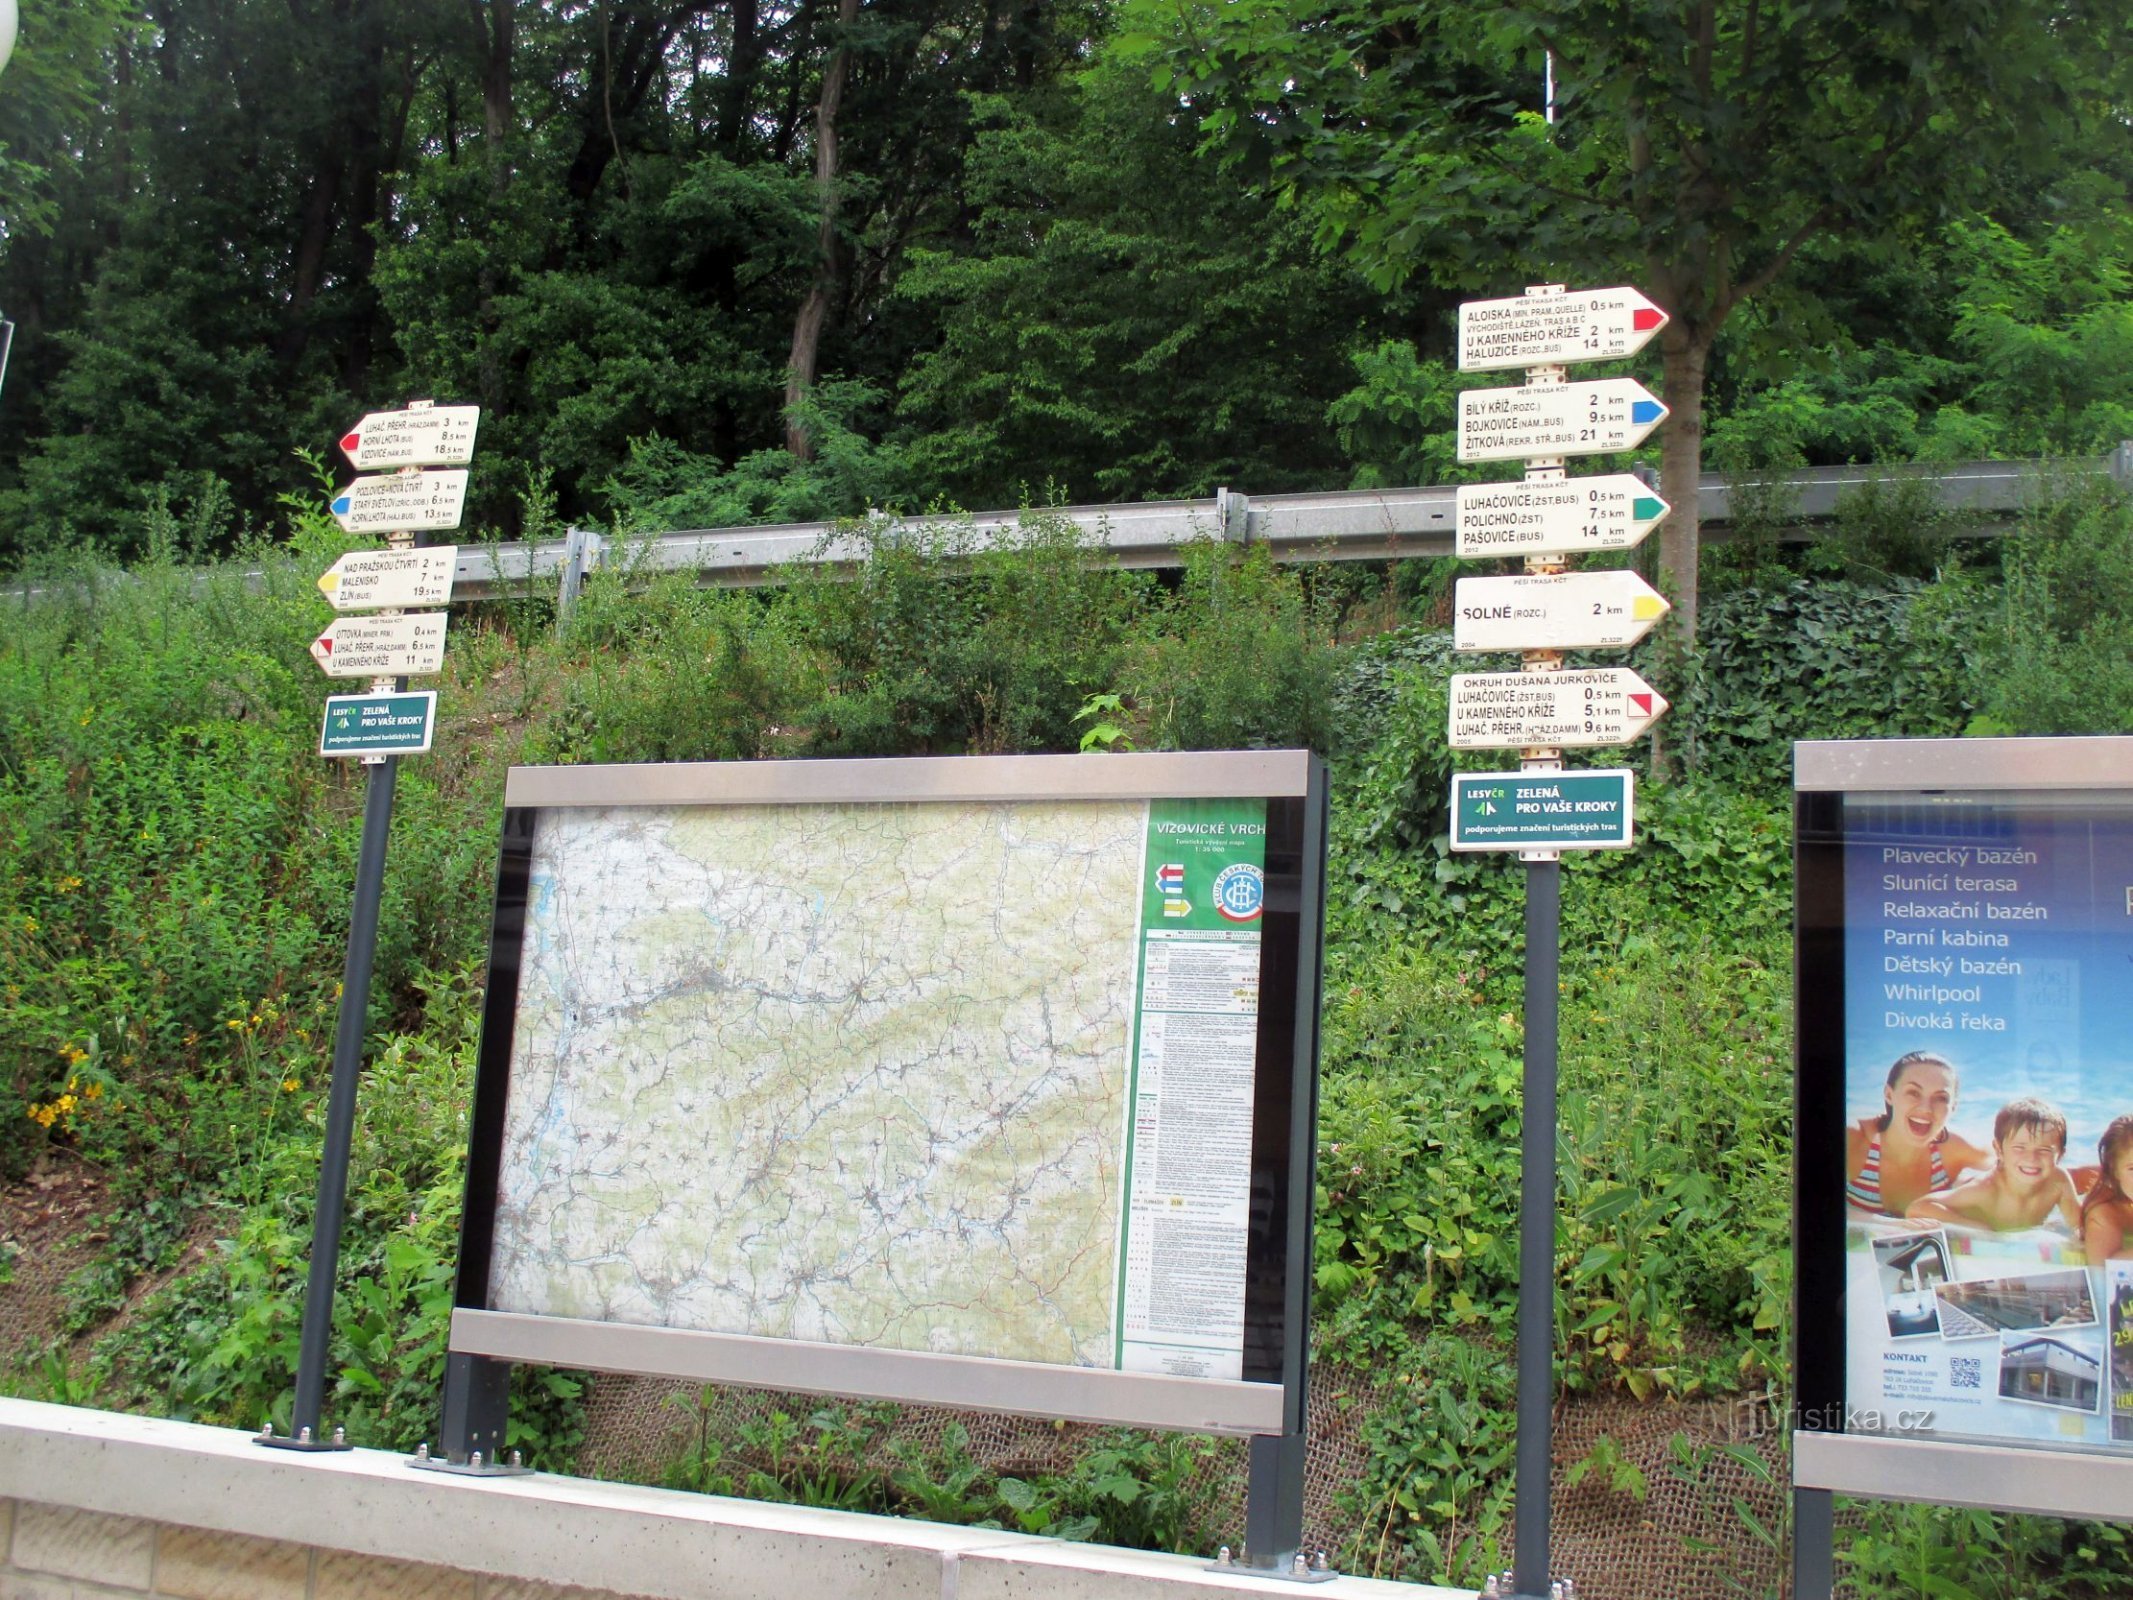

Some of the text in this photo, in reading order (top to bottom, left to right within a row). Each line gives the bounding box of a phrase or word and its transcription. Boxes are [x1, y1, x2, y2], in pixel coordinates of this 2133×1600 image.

[1467, 308, 1512, 322] ALOISKA
[1590, 300, 1606, 312] 0,5
[1609, 301, 1624, 309] km
[1544, 317, 1564, 326] TRAS
[1566, 316, 1572, 324] A
[1572, 316, 1578, 324] B
[1466, 325, 1624, 347] U KAMENNÉHO KŘÍŽE 2 km
[1466, 345, 1518, 360] HALUZICE
[1584, 338, 1598, 349] 14
[1466, 394, 1624, 416] BÍLÝ KŘÍŽ (ROZC.) 2 km
[444, 418, 450, 427] 3
[1466, 418, 1518, 432] BOJKOVICE
[1590, 412, 1606, 423] 9,5
[363, 436, 380, 446] HORNÍ
[380, 436, 400, 445] LHOTA
[442, 432, 454, 441] 8,5
[1466, 433, 1505, 450] ŽITKOVÁ
[1580, 429, 1596, 440] 21
[361, 449, 387, 460] VIZOVICE
[434, 444, 452, 454] 18,5
[434, 482, 440, 491] 3
[432, 496, 442, 504] 6,5
[1464, 494, 1531, 510] LUHAČOVICE
[1590, 490, 1606, 502] 0,5
[1610, 492, 1624, 500] km
[369, 512, 386, 522] LHOTA
[425, 509, 440, 518] 13,5
[1464, 508, 1624, 527] POLICHNO (ŽST) 7,5 km
[1464, 525, 1624, 544] PAŠOVICE (BUS) 14 km
[344, 564, 358, 573] NAD
[360, 560, 393, 572] PRAŽSKOU
[394, 558, 418, 570] ČTVRTÍ
[422, 558, 428, 568] 2
[342, 576, 378, 587] MALENISKO
[421, 572, 427, 582] 7
[340, 590, 354, 600] ZLÍN
[354, 592, 372, 600] (BUS)
[414, 586, 430, 596] 19,5
[1463, 604, 1622, 620] SOLNÉ (ROZC.) 2 km
[336, 629, 362, 640] OTTOVKA
[414, 626, 424, 636] 0,4
[412, 640, 424, 650] 6,5
[332, 658, 338, 668] U
[338, 656, 372, 668] KAMENNÉHO
[372, 654, 390, 666] KŘÍŽE
[406, 655, 416, 664] 11
[1464, 673, 1617, 688] OKRUH DUŠANA JURKOVIČE
[1458, 688, 1516, 704] LUHAČOVICE
[1584, 688, 1602, 700] 0,5
[362, 704, 390, 716] ZELENÁ
[1458, 702, 1620, 719] U KAMENNÉHO KŘÍŽE 5,1 km
[361, 716, 424, 727] PRO VAŠE KROKY
[1456, 720, 1620, 736] LUHAČ. PŘEHR. 9,6 km
[1516, 785, 1560, 798] ZELENÁ
[1516, 800, 1617, 814] PRO VAŠE KROKY
[1156, 821, 1226, 834] VIZOVICKÉ
[1465, 825, 1518, 835] podporujeme
[1520, 824, 1551, 832] značení
[1552, 823, 1600, 833] turistických
[1883, 848, 2038, 867] Plavecký bazén
[1883, 874, 2018, 892] Slunící terasa
[1884, 901, 2048, 920] Relaxační bazén
[1884, 928, 2010, 947] Parní kabina
[1884, 956, 2022, 976] Dětský bazén
[1884, 984, 1981, 1004] Whirlpool
[1885, 1012, 2006, 1030] Divoká řeka
[1883, 1352, 1928, 1363] KONTAKT
